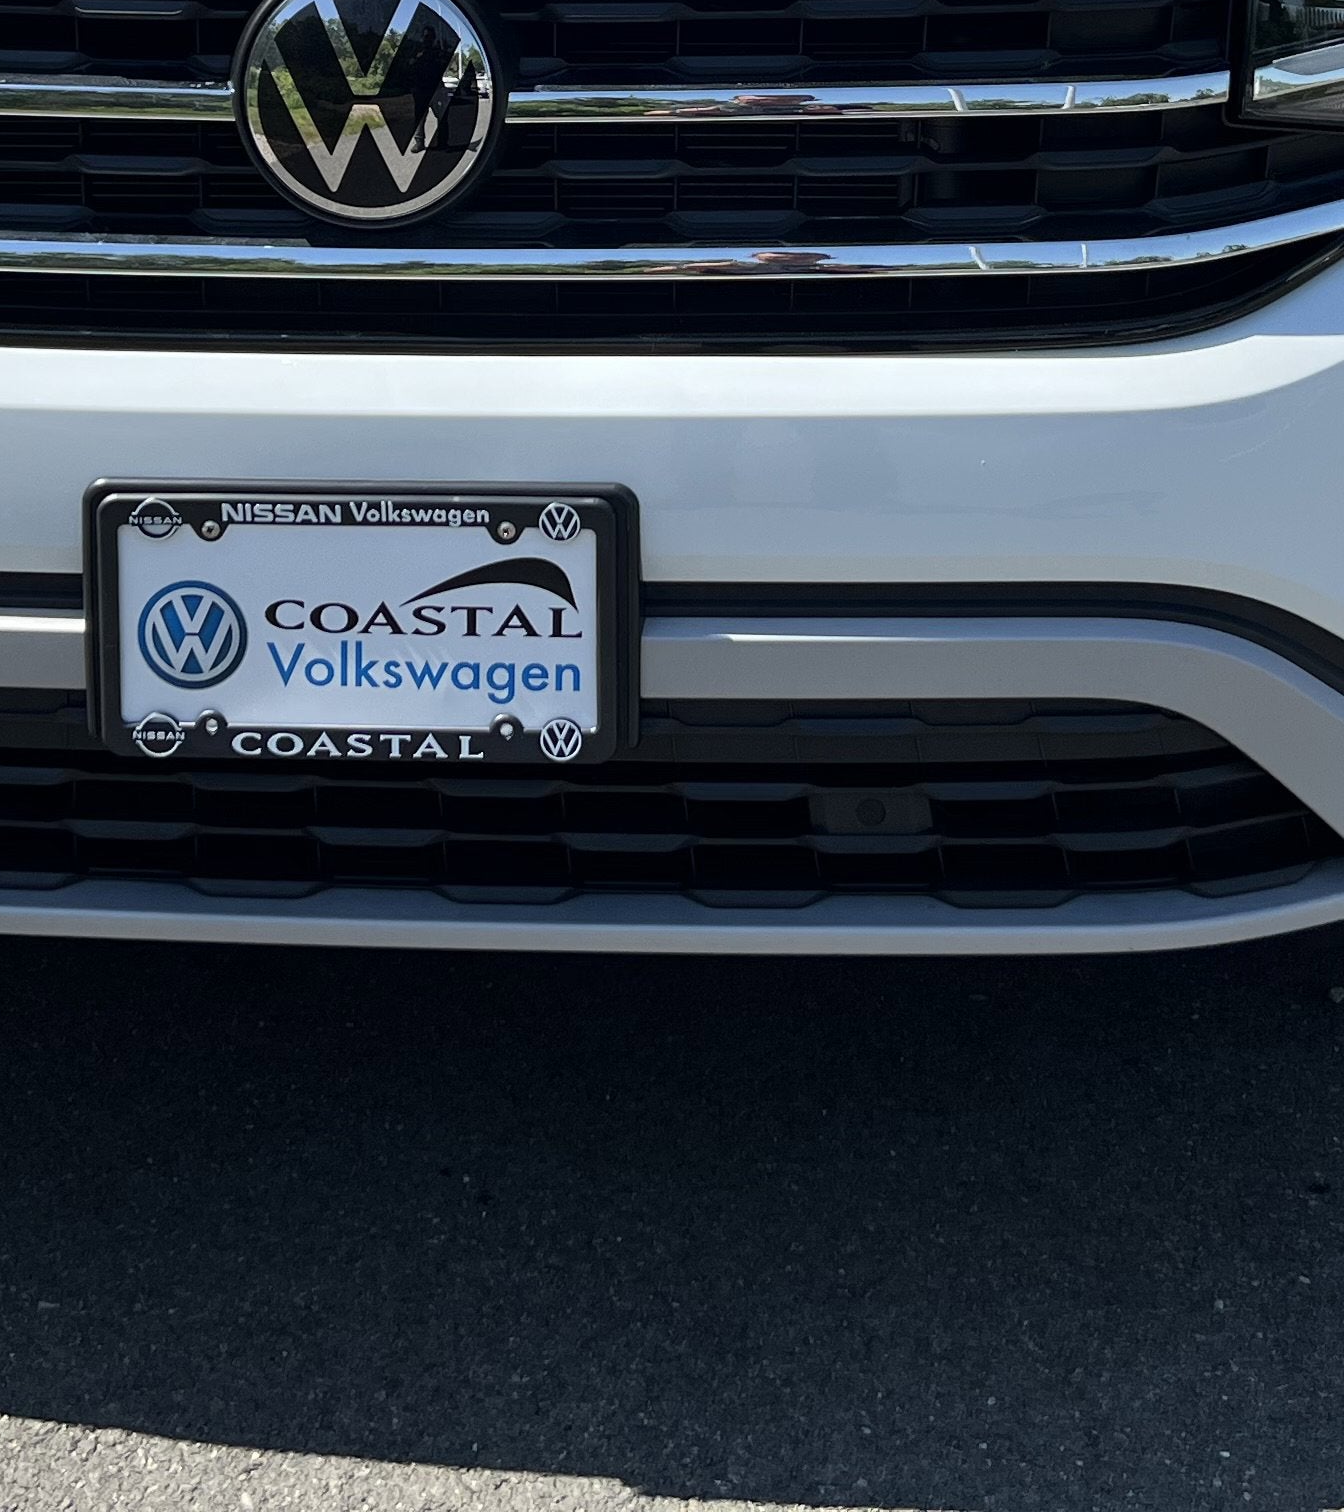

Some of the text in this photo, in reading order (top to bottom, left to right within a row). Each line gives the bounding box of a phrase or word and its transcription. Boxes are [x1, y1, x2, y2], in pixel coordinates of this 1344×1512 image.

[128, 514, 184, 526] NISSAN
[221, 500, 491, 528] NISSAN Volkswagen
[264, 598, 584, 639] COASTAL
[266, 639, 582, 705] Volkswagen
[132, 730, 186, 742] NISSAN
[231, 730, 486, 760] COASTAL
